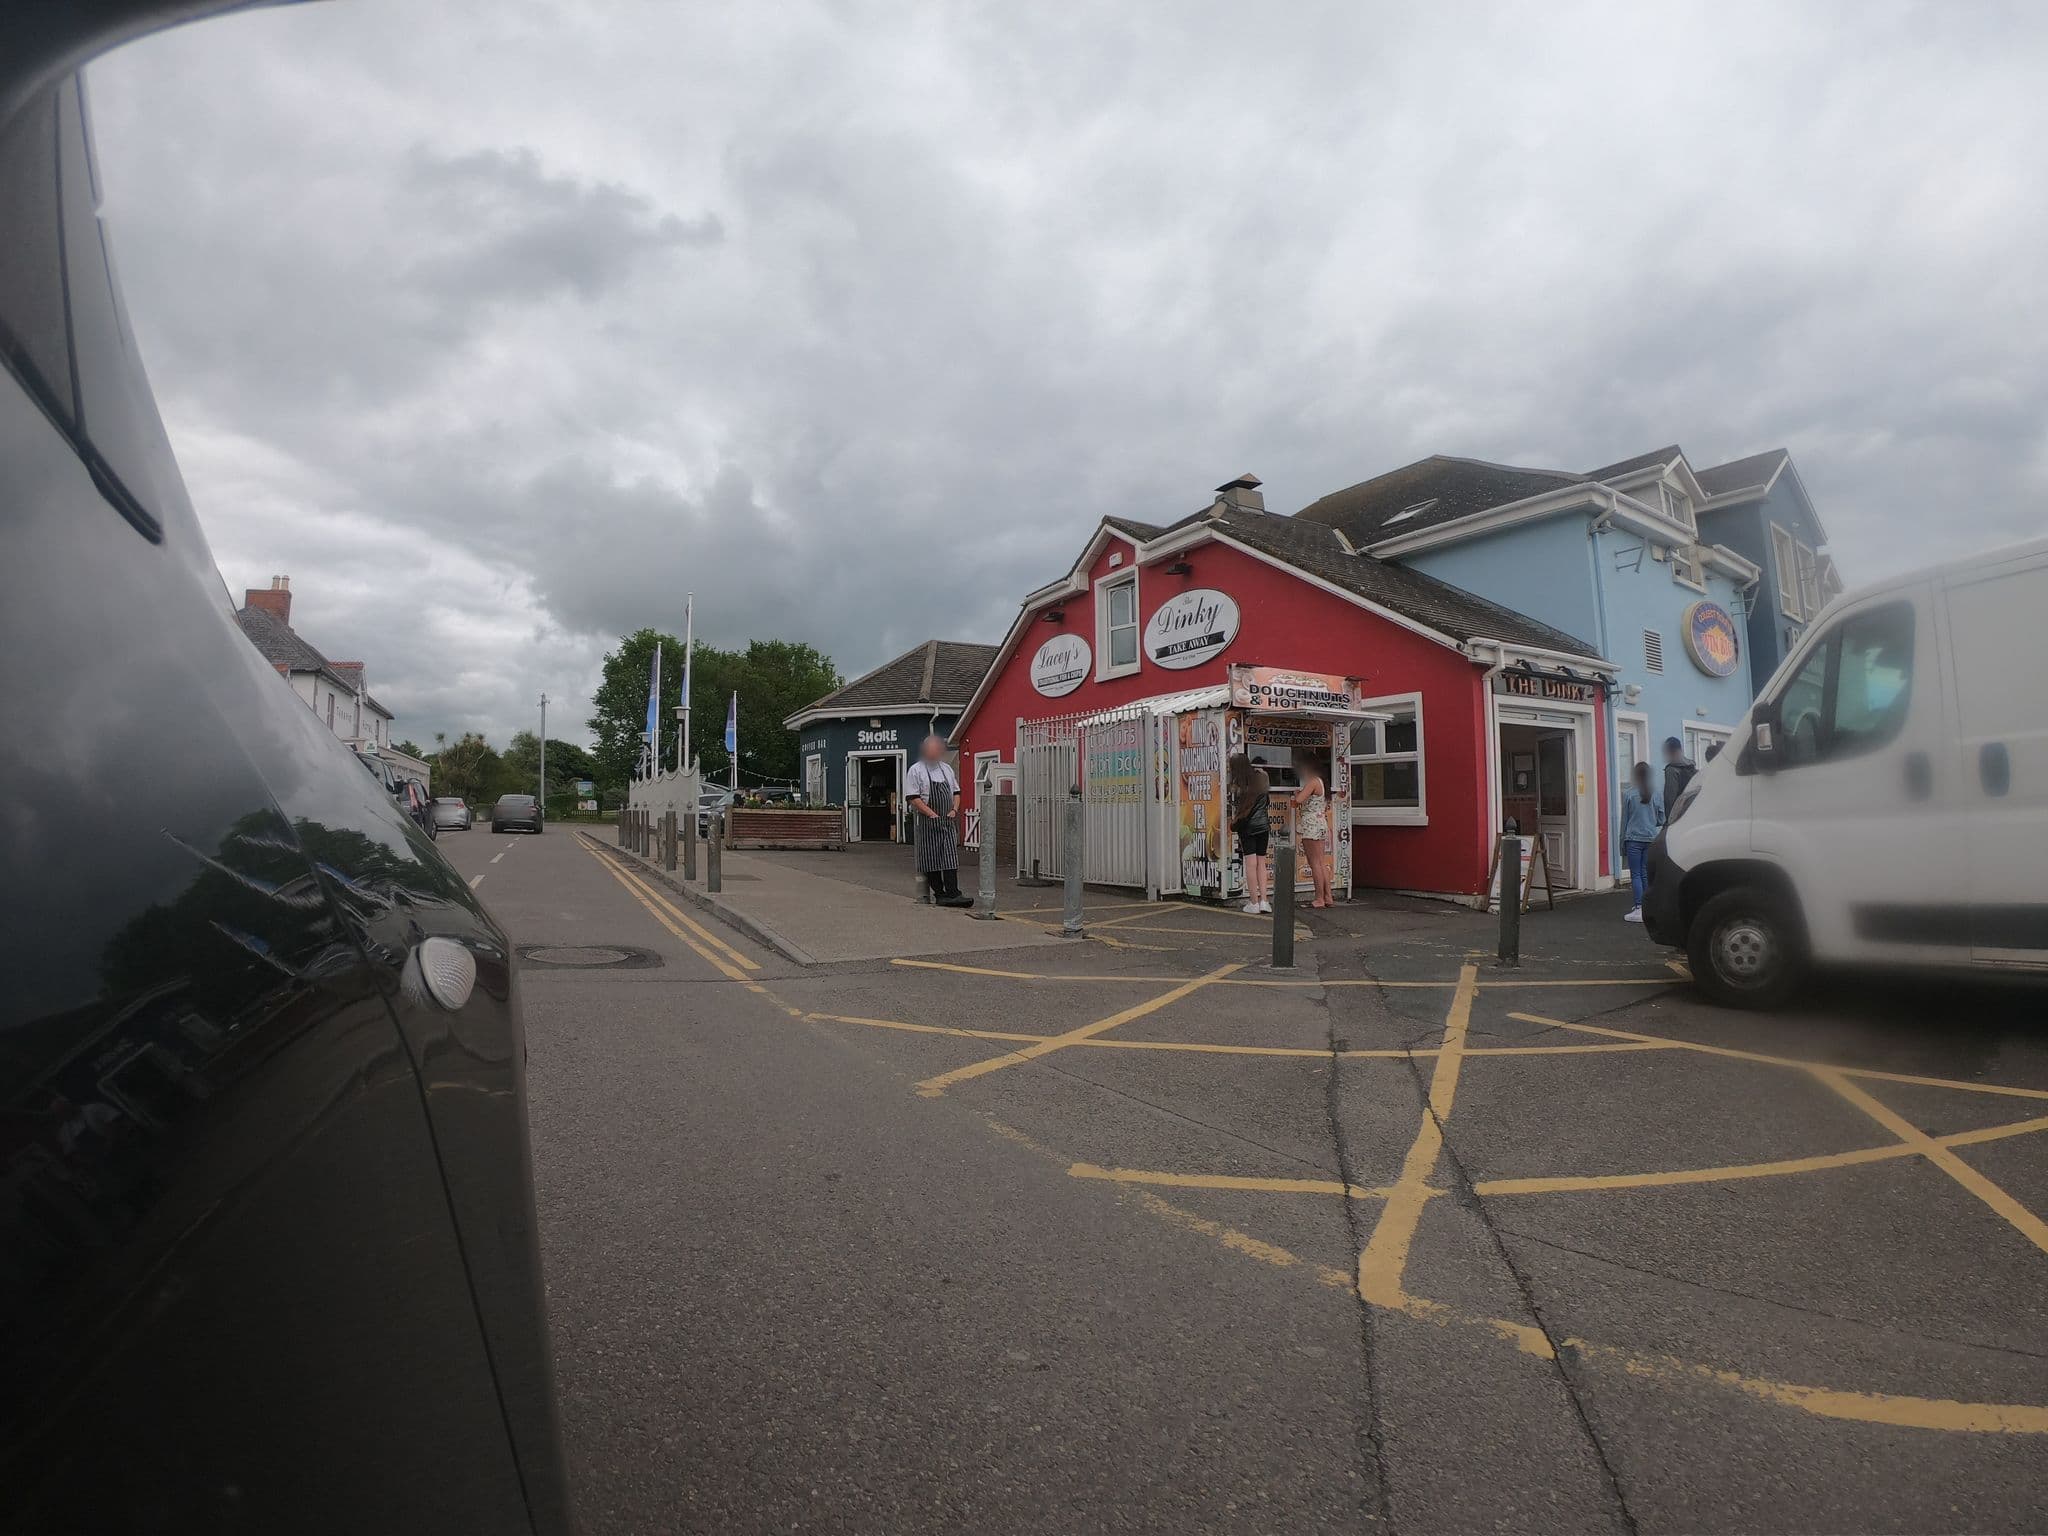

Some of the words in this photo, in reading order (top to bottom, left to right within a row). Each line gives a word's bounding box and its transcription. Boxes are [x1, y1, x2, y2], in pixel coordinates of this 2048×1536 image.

[1157, 597, 1223, 635] Dinky
[1167, 642, 1187, 655] TAKE
[1188, 636, 1211, 650] AWAY
[1037, 642, 1081, 672] Lacey's
[1249, 684, 1350, 703] DOUGHNUTS
[1508, 676, 1537, 695] THE
[1249, 695, 1261, 706] &
[1268, 697, 1299, 709] HOT
[857, 729, 898, 743] SHORE
[1248, 727, 1328, 740] DOUGHNUTS
[1263, 736, 1289, 745] HOT
[1181, 745, 1219, 773] DOUGHNUTS
[1188, 775, 1211, 801] COFFEE
[1193, 804, 1206, 829] TEA
[1193, 832, 1206, 858] HOT
[1183, 860, 1220, 887] CHOCOLATE
